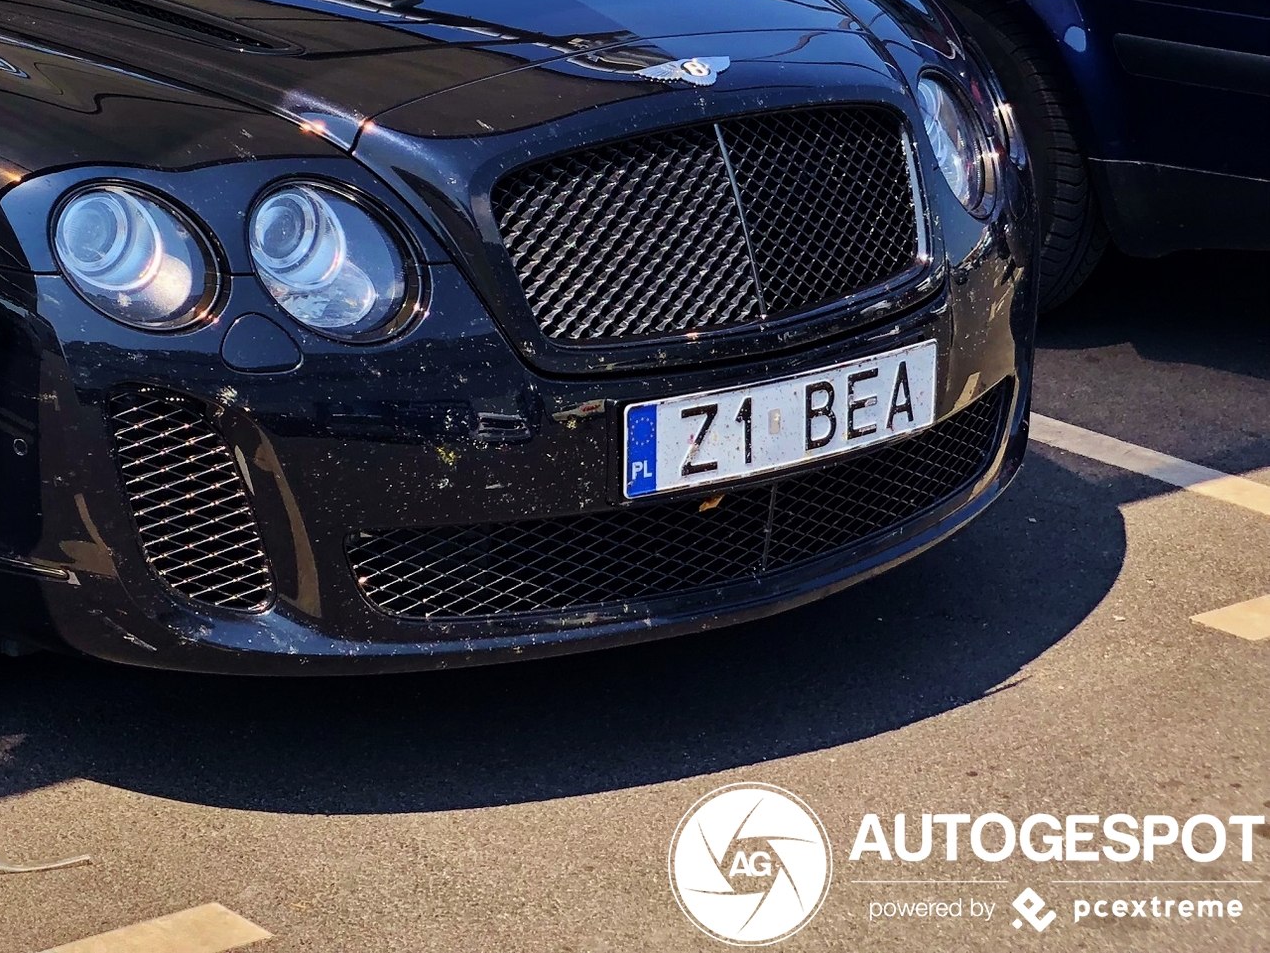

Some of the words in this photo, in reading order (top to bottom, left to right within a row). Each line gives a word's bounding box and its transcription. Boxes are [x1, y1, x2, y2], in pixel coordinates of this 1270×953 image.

[680, 396, 752, 477] Z1
[804, 360, 915, 451] BEA
[631, 459, 653, 481] PL
